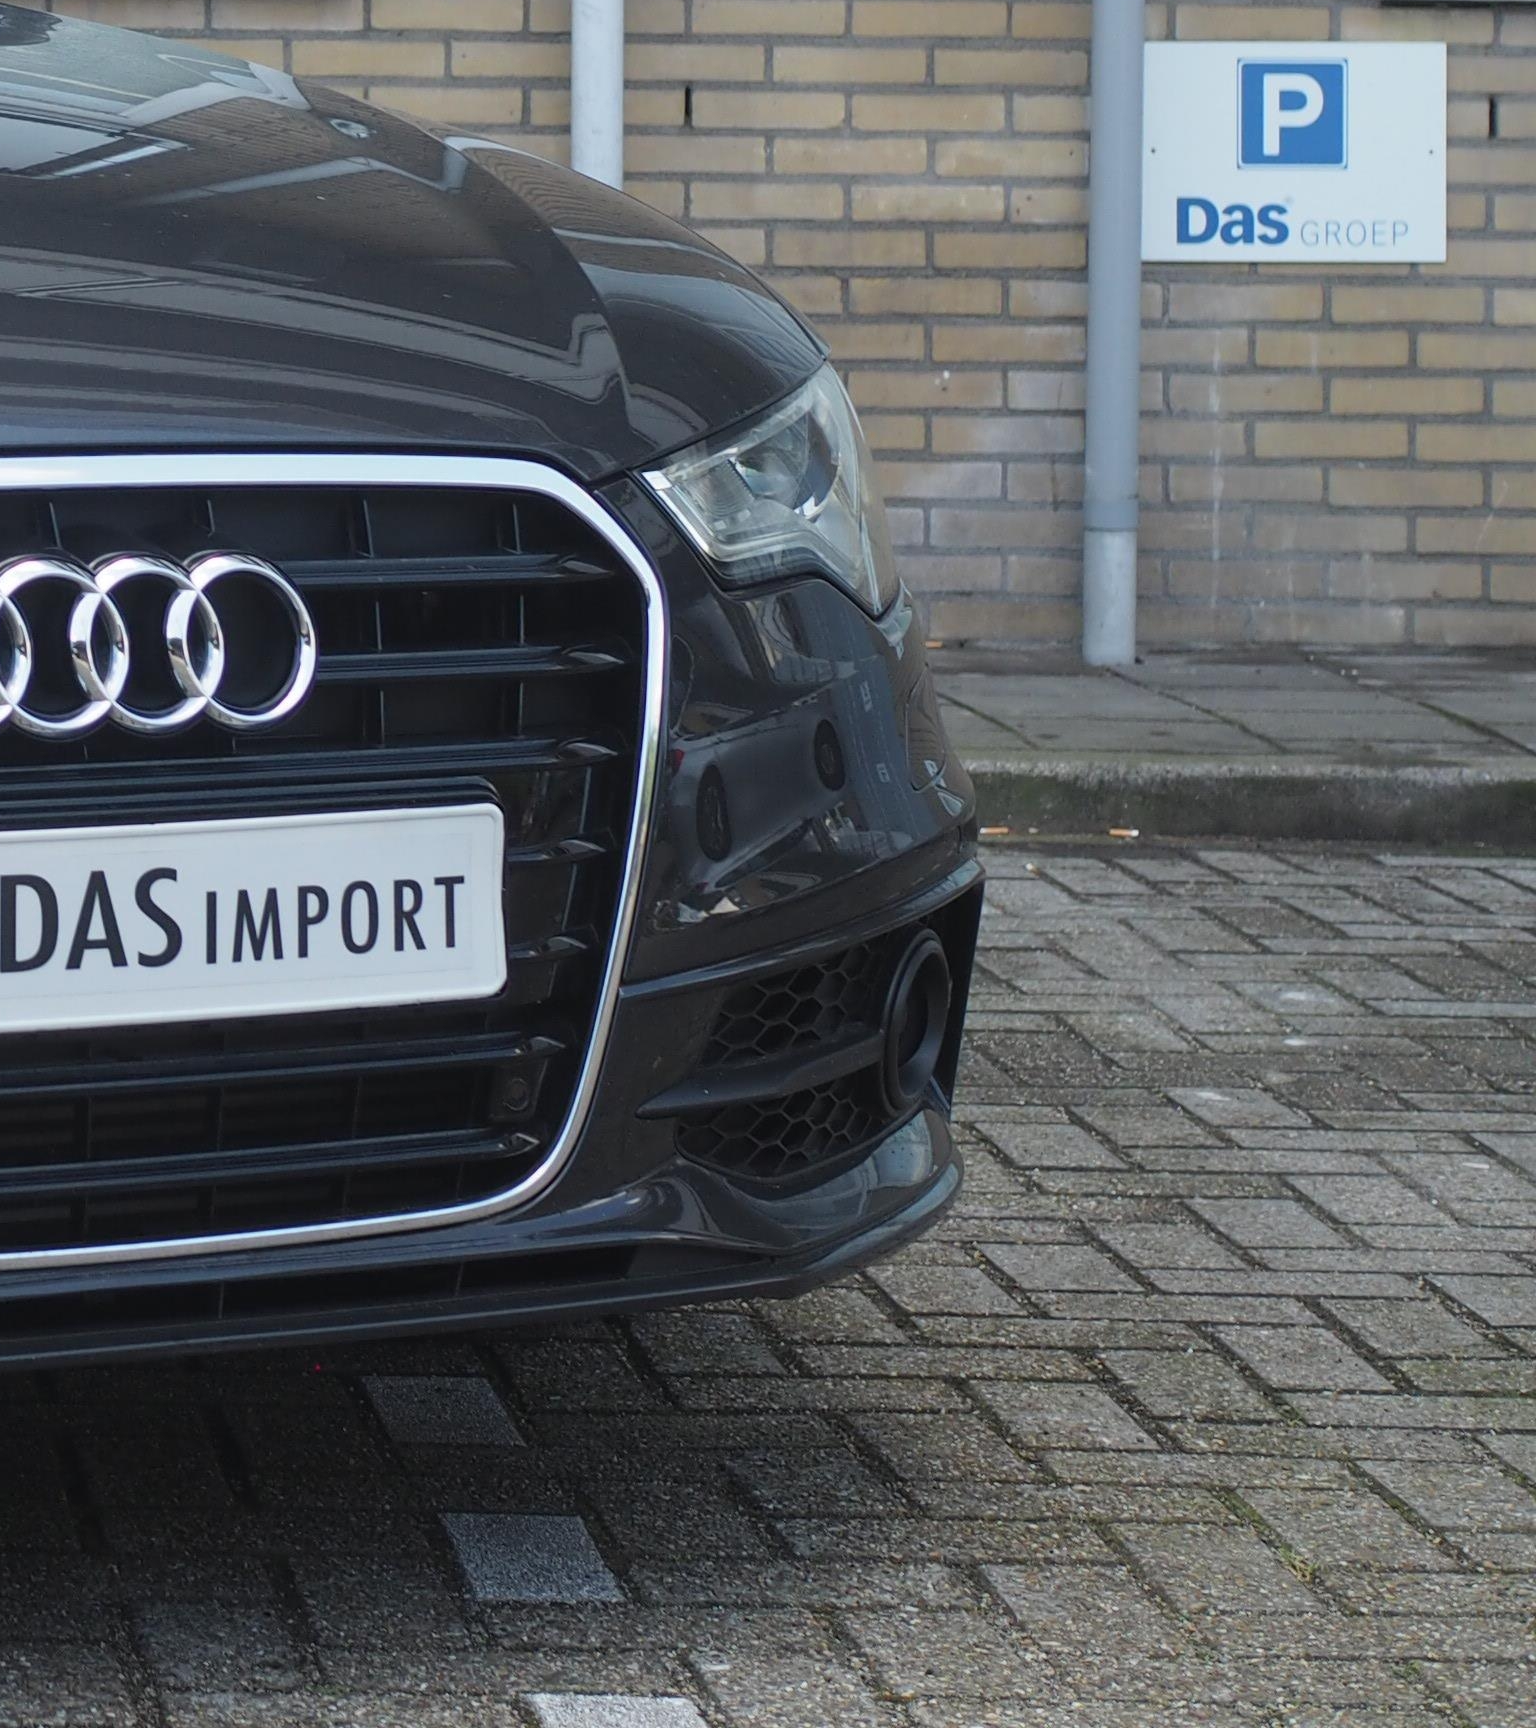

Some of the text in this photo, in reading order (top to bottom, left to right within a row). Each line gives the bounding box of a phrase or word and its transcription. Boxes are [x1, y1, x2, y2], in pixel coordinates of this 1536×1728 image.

[1263, 73, 1324, 156] P
[1176, 196, 1410, 248] Das GROEP
[205, 875, 465, 964] IMPORT
